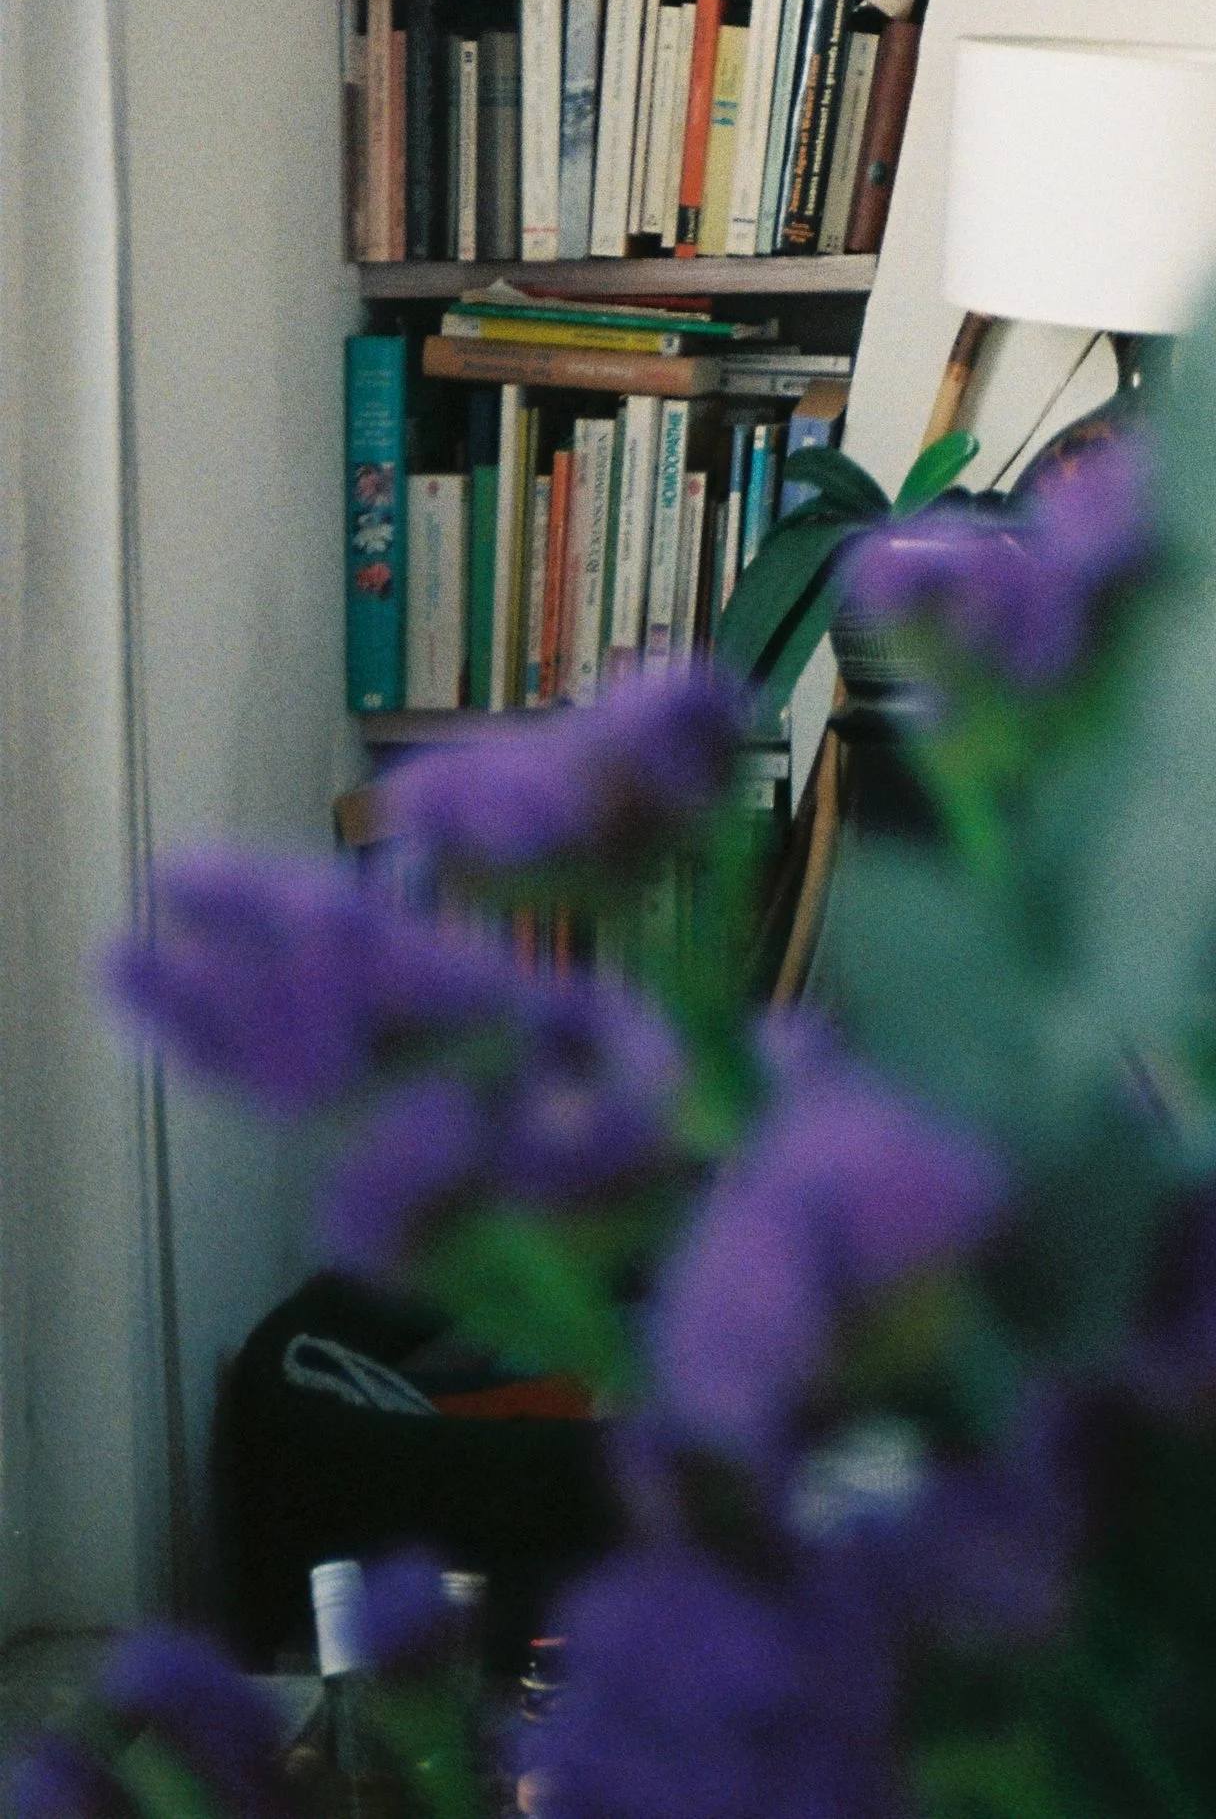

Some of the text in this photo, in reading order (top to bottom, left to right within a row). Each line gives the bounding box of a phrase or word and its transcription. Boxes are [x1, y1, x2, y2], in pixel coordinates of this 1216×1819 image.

[823, 45, 840, 85] grands
[820, 88, 832, 105] les
[811, 106, 829, 173] maintenant
[795, 145, 810, 174] Agee
[789, 177, 804, 213] James
[805, 175, 820, 216] Louons
